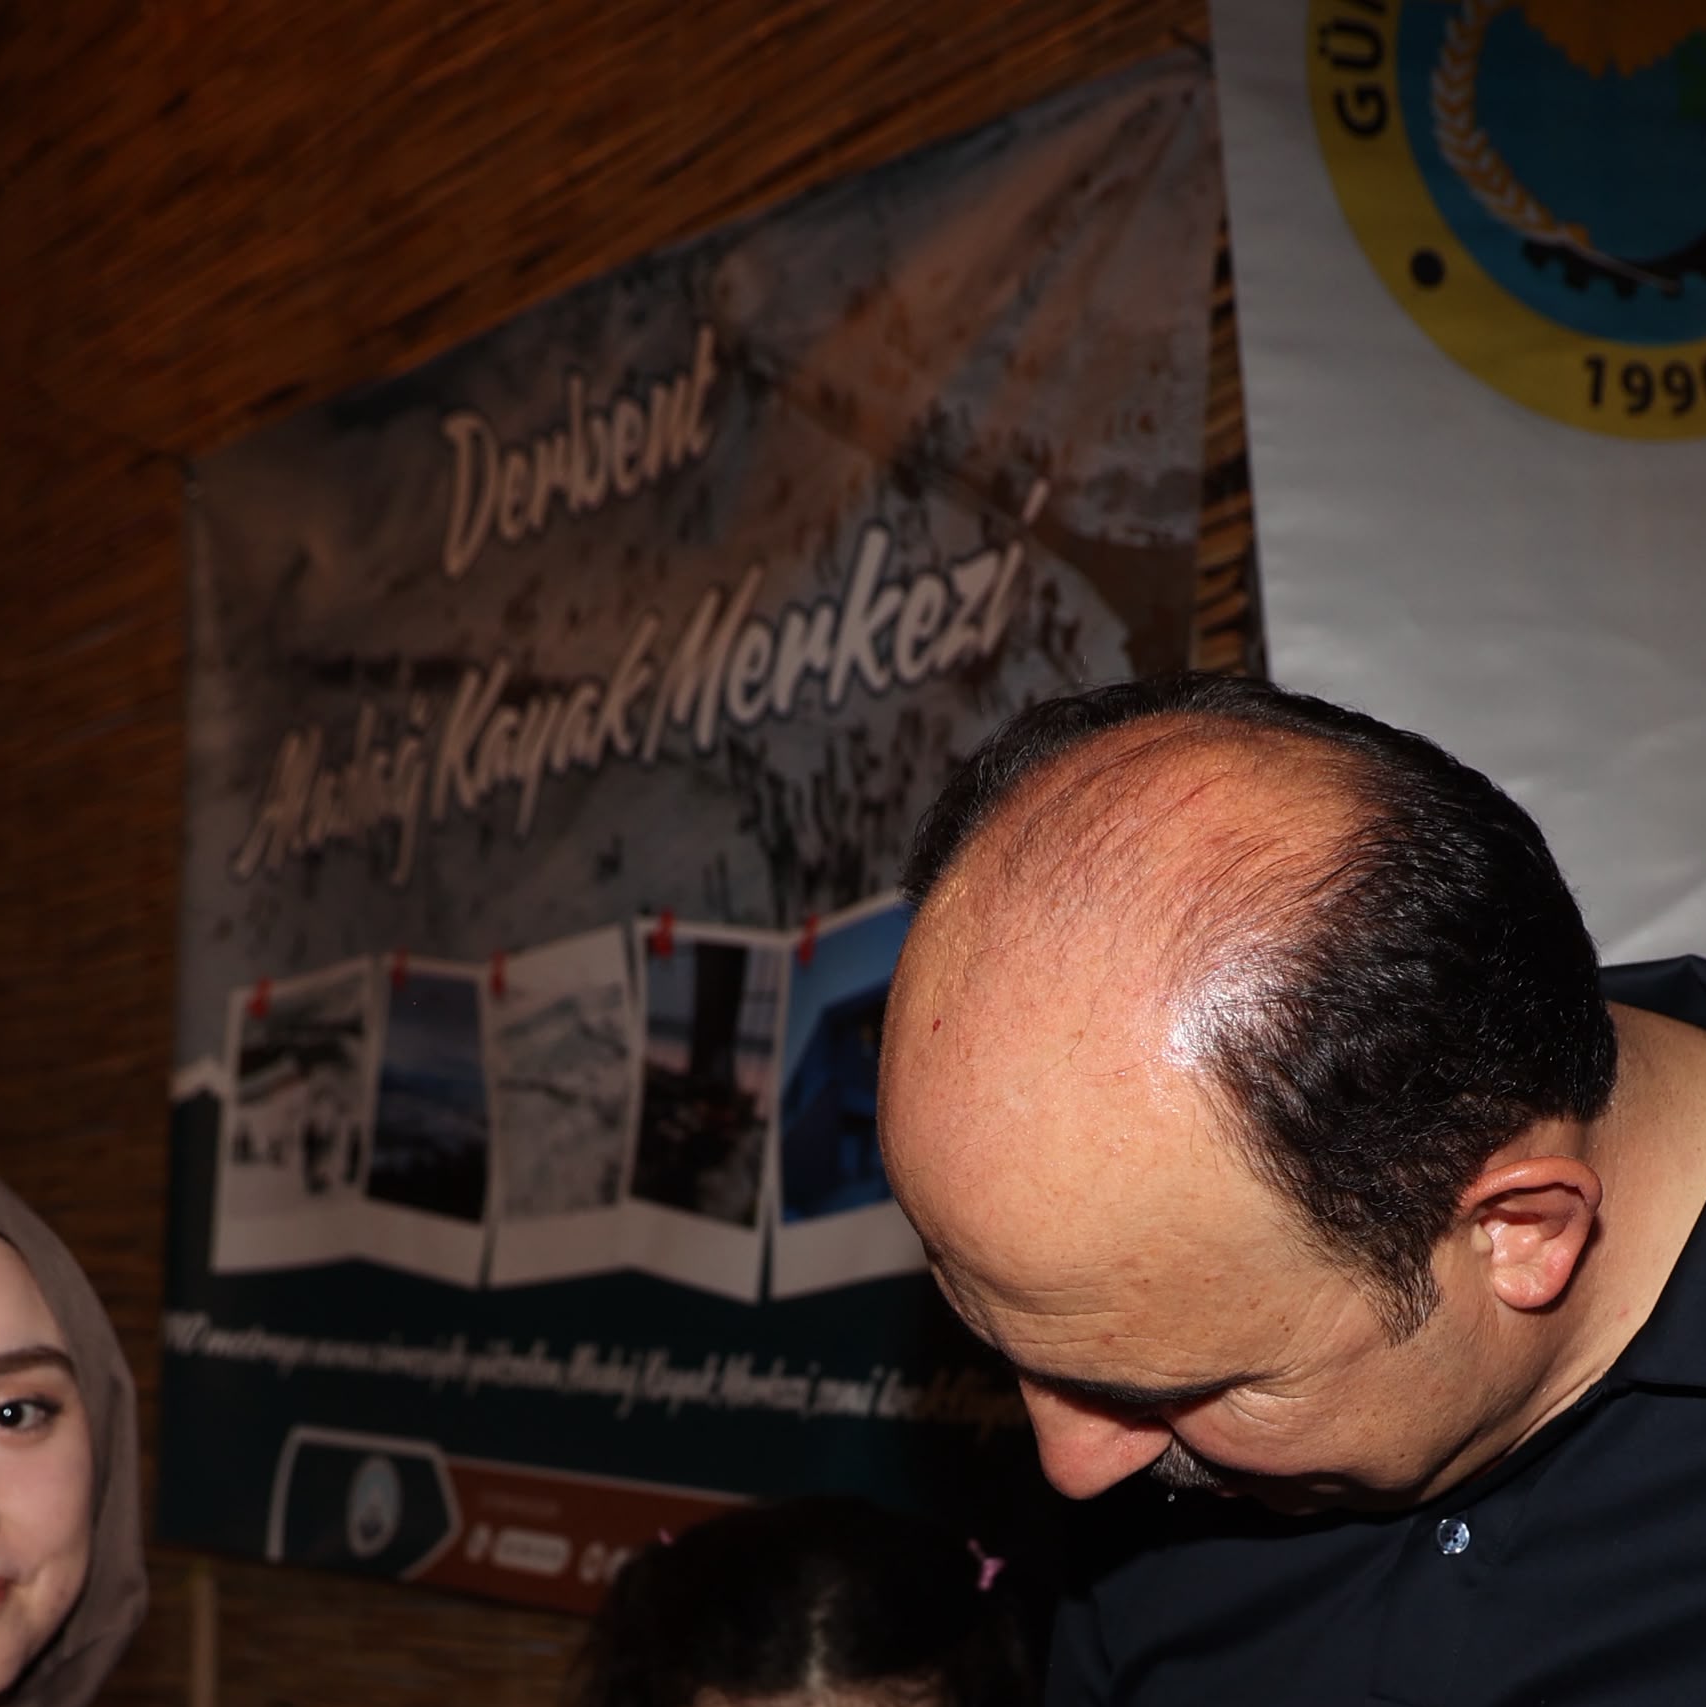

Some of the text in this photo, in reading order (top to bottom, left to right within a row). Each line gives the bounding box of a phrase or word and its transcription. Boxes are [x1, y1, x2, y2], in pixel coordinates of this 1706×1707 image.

[1317, 0, 1391, 137] GÜ
[442, 323, 720, 578] Derbent
[429, 612, 663, 838] Kayak
[645, 476, 1051, 758] Merkezi
